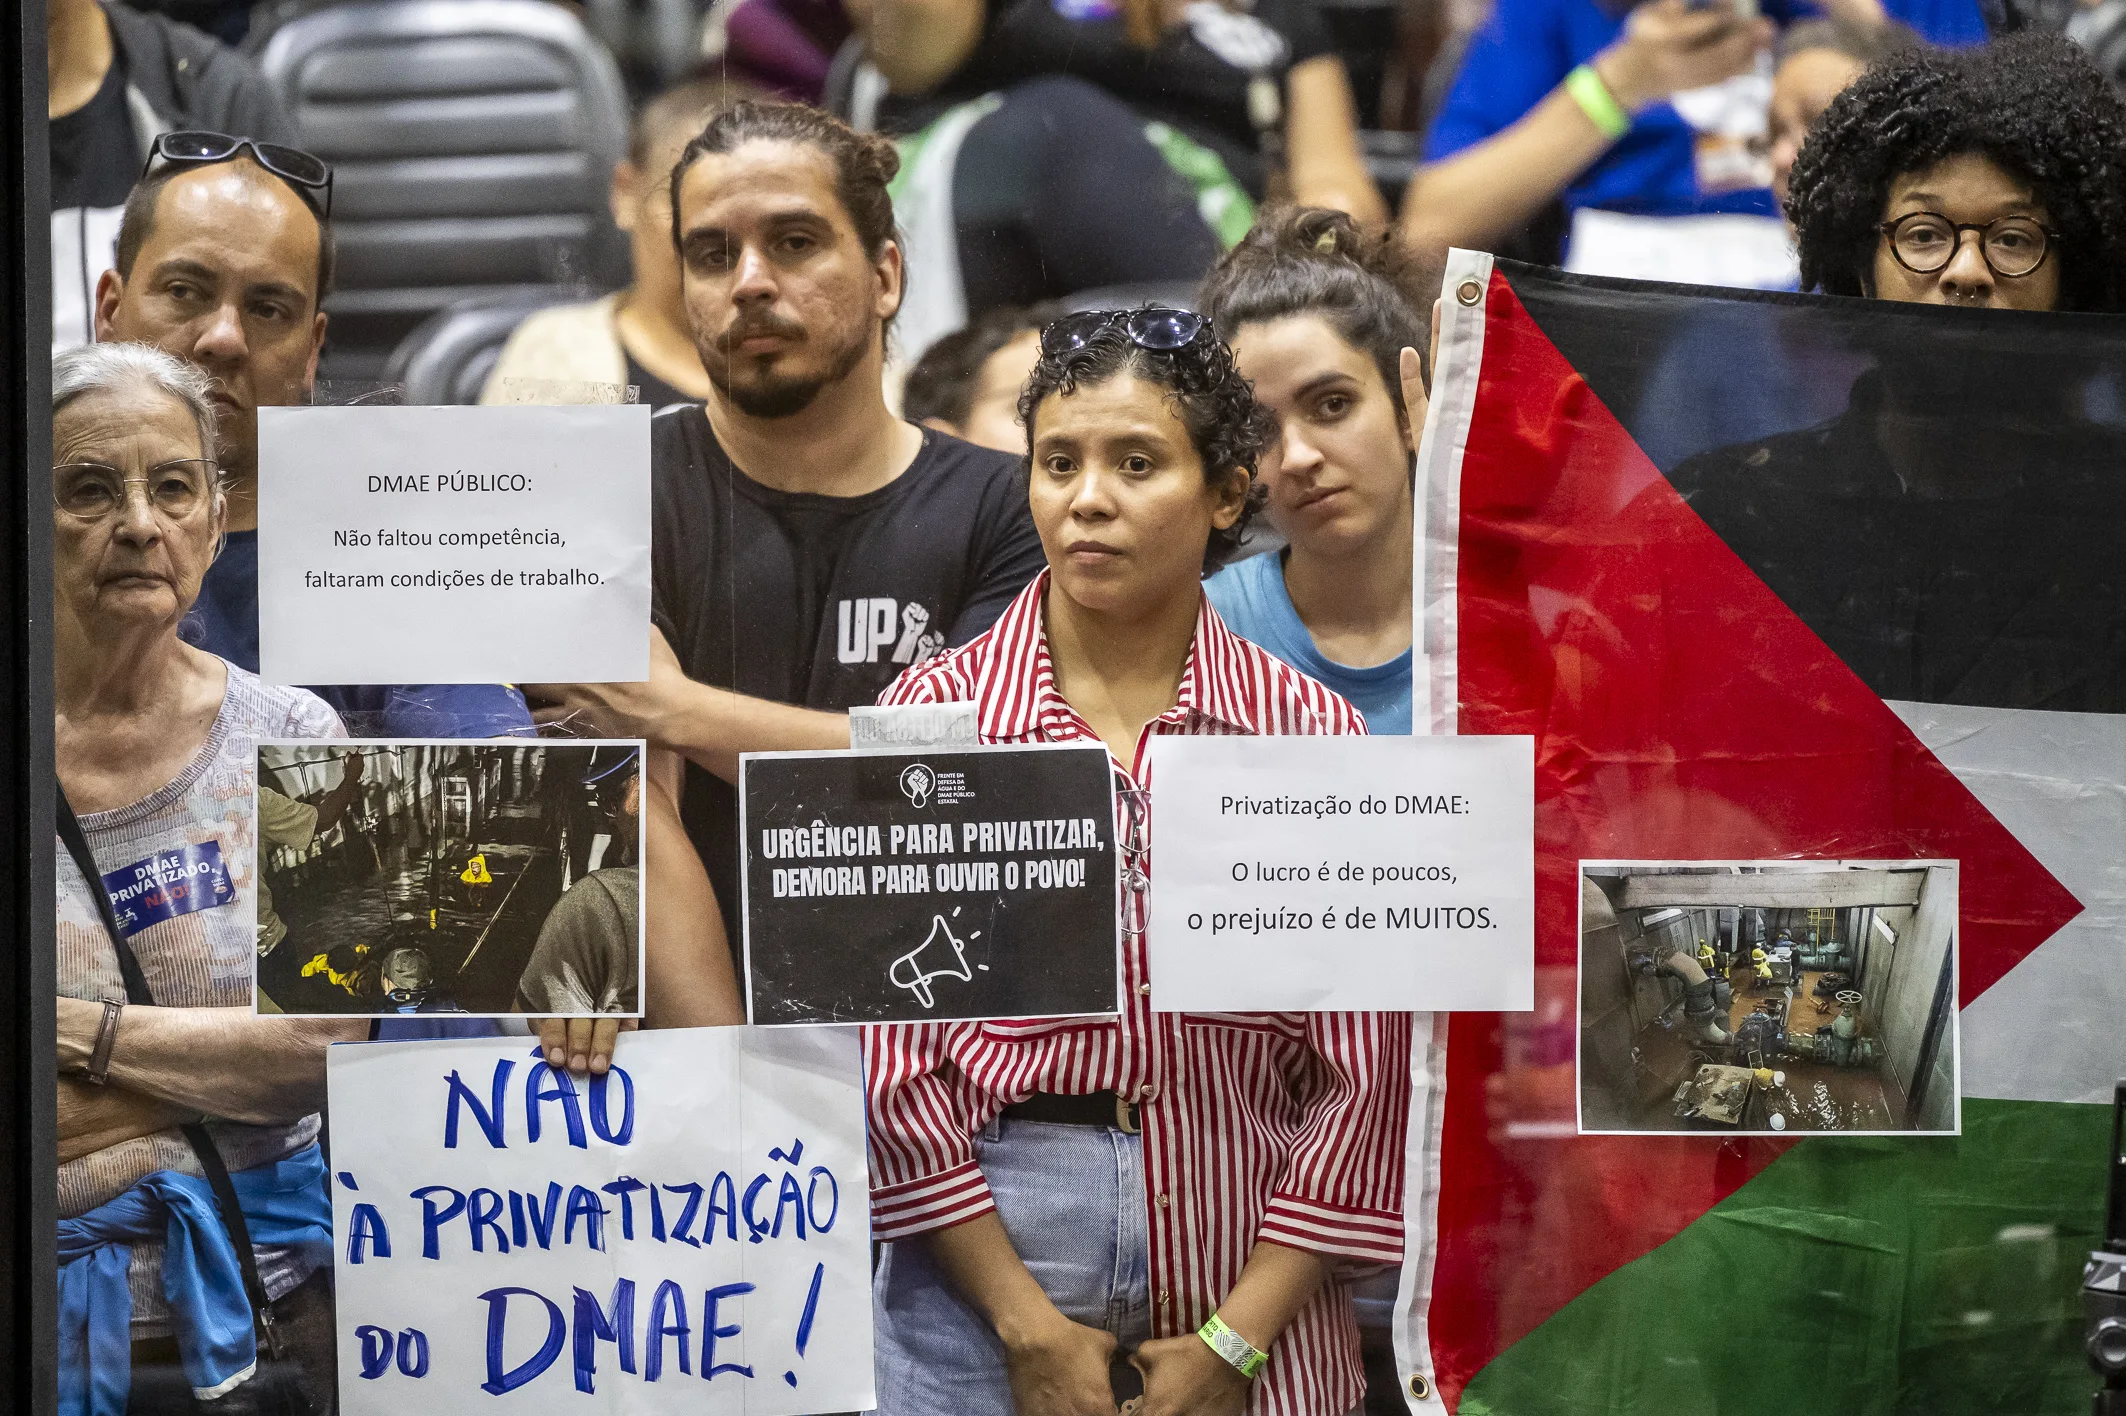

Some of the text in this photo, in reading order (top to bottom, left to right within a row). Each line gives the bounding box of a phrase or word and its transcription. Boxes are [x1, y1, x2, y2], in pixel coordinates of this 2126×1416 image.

[368, 469, 532, 492] DMAE PÚBLICO:
[334, 527, 566, 550] Não faltou competência,
[304, 568, 605, 591] faltaram condições de trabalho.
[837, 597, 898, 664] UP
[1221, 794, 1469, 820] Privatização do DMAE:
[762, 818, 1105, 859] URGÊNCIA PARA PRIVATIZAR,
[109, 861, 217, 905] PRIVATIZADO,
[134, 855, 180, 880] DMAE
[772, 857, 1085, 898] DEMORA PARA OUVIR O POVO!
[1232, 860, 1457, 886] O lucro é de poucos,
[1187, 905, 1497, 936] o prejuízo é de MUITOS.
[444, 1045, 635, 1150] NÃO
[335, 1138, 840, 1265] À PRIVATIZAÇÃO
[354, 1324, 431, 1380] DO
